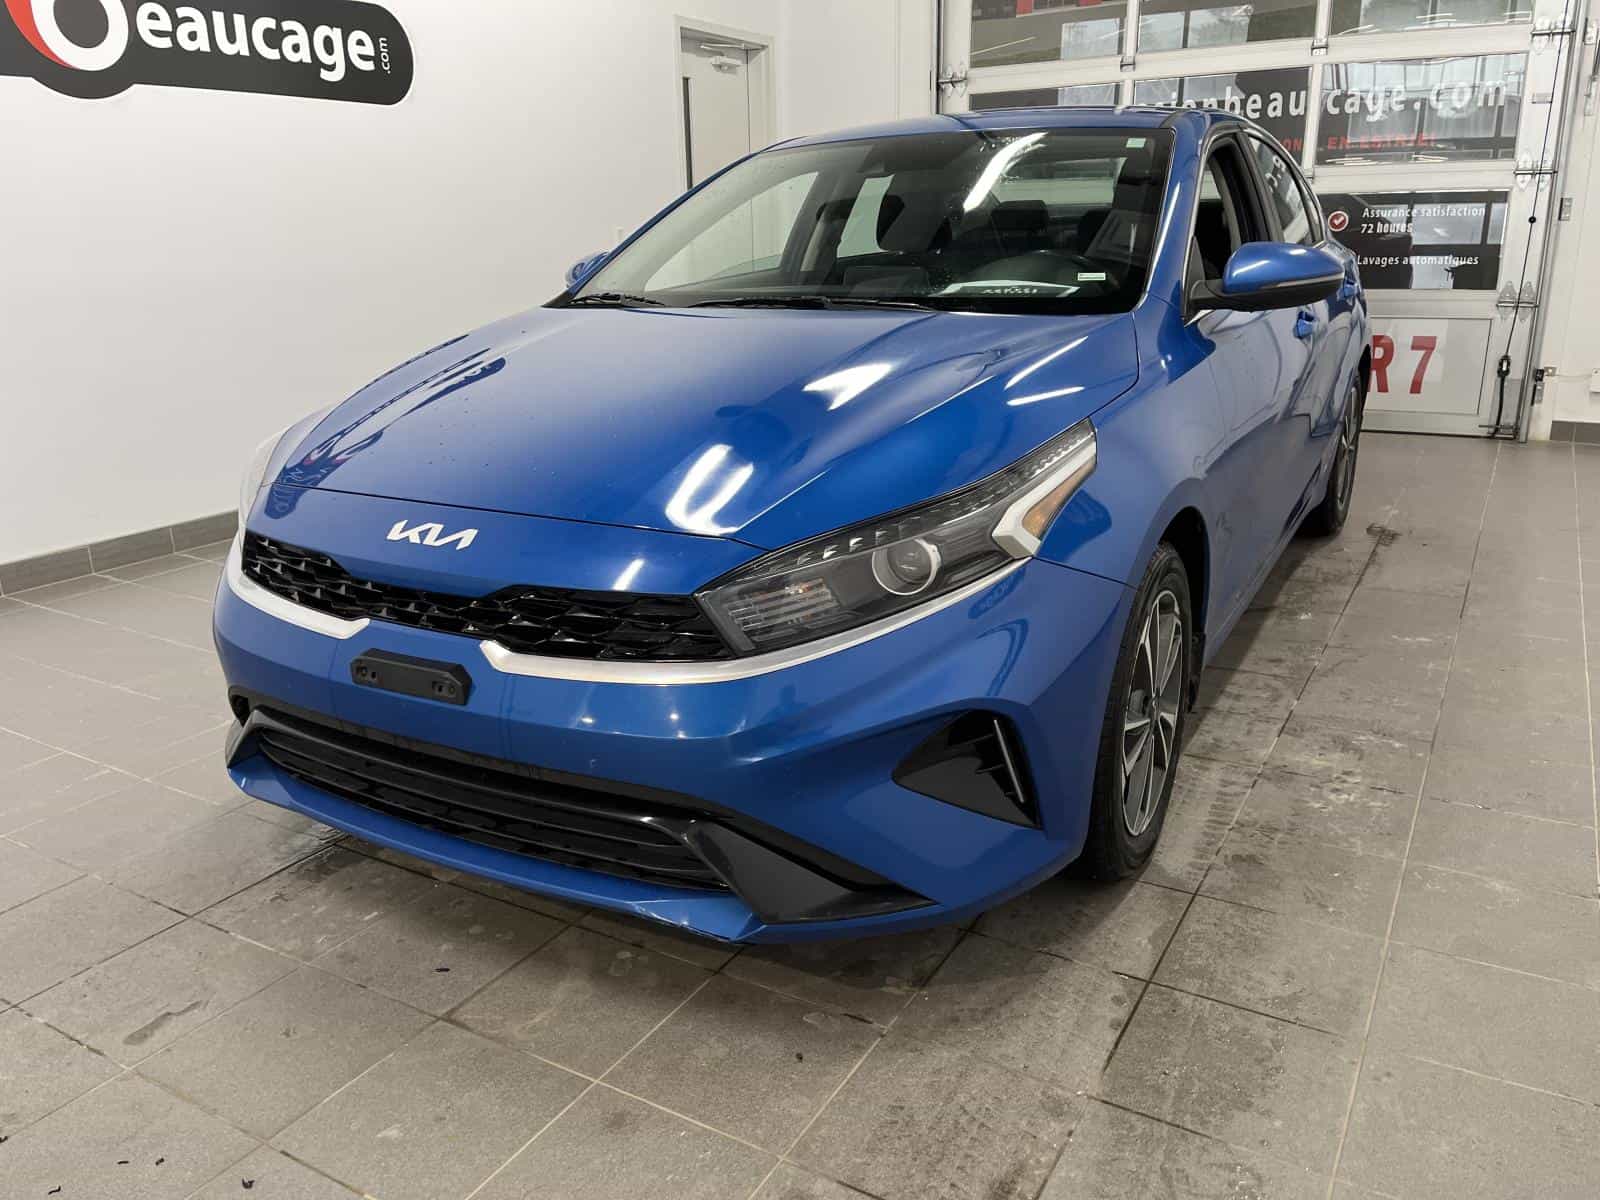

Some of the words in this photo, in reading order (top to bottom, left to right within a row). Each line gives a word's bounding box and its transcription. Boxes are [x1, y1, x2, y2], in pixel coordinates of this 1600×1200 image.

[379, 37, 391, 74] .com
[1361, 206, 1418, 218] Assurance
[1419, 205, 1486, 217] satisfaction
[1360, 223, 1374, 234] 72
[1357, 254, 1400, 268] Lavages
[1402, 253, 1480, 267] automatiques
[1409, 335, 1438, 394] 7
[386, 519, 478, 550] KIA
